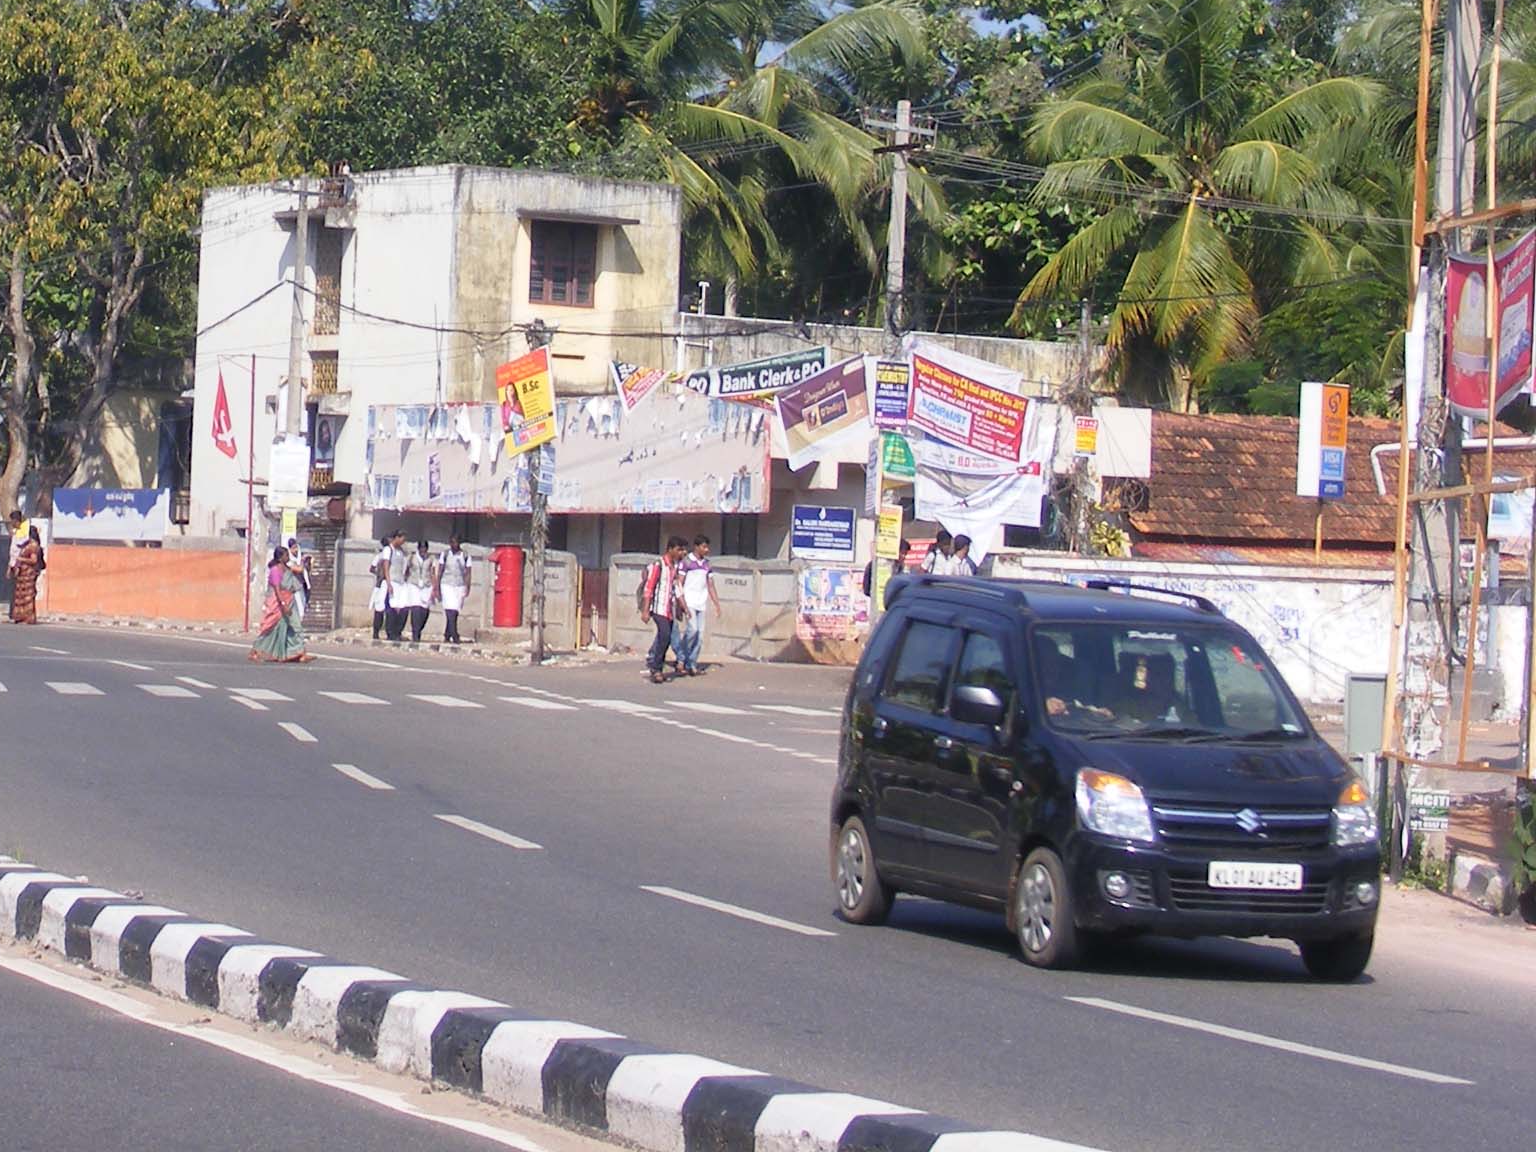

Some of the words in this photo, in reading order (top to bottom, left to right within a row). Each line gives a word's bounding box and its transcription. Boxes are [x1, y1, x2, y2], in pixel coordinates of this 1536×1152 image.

[722, 374, 755, 393] Bank
[759, 365, 793, 389] Clerk
[1215, 869, 1230, 885] KL
[1232, 869, 1245, 885] 01
[1248, 870, 1265, 886] AU
